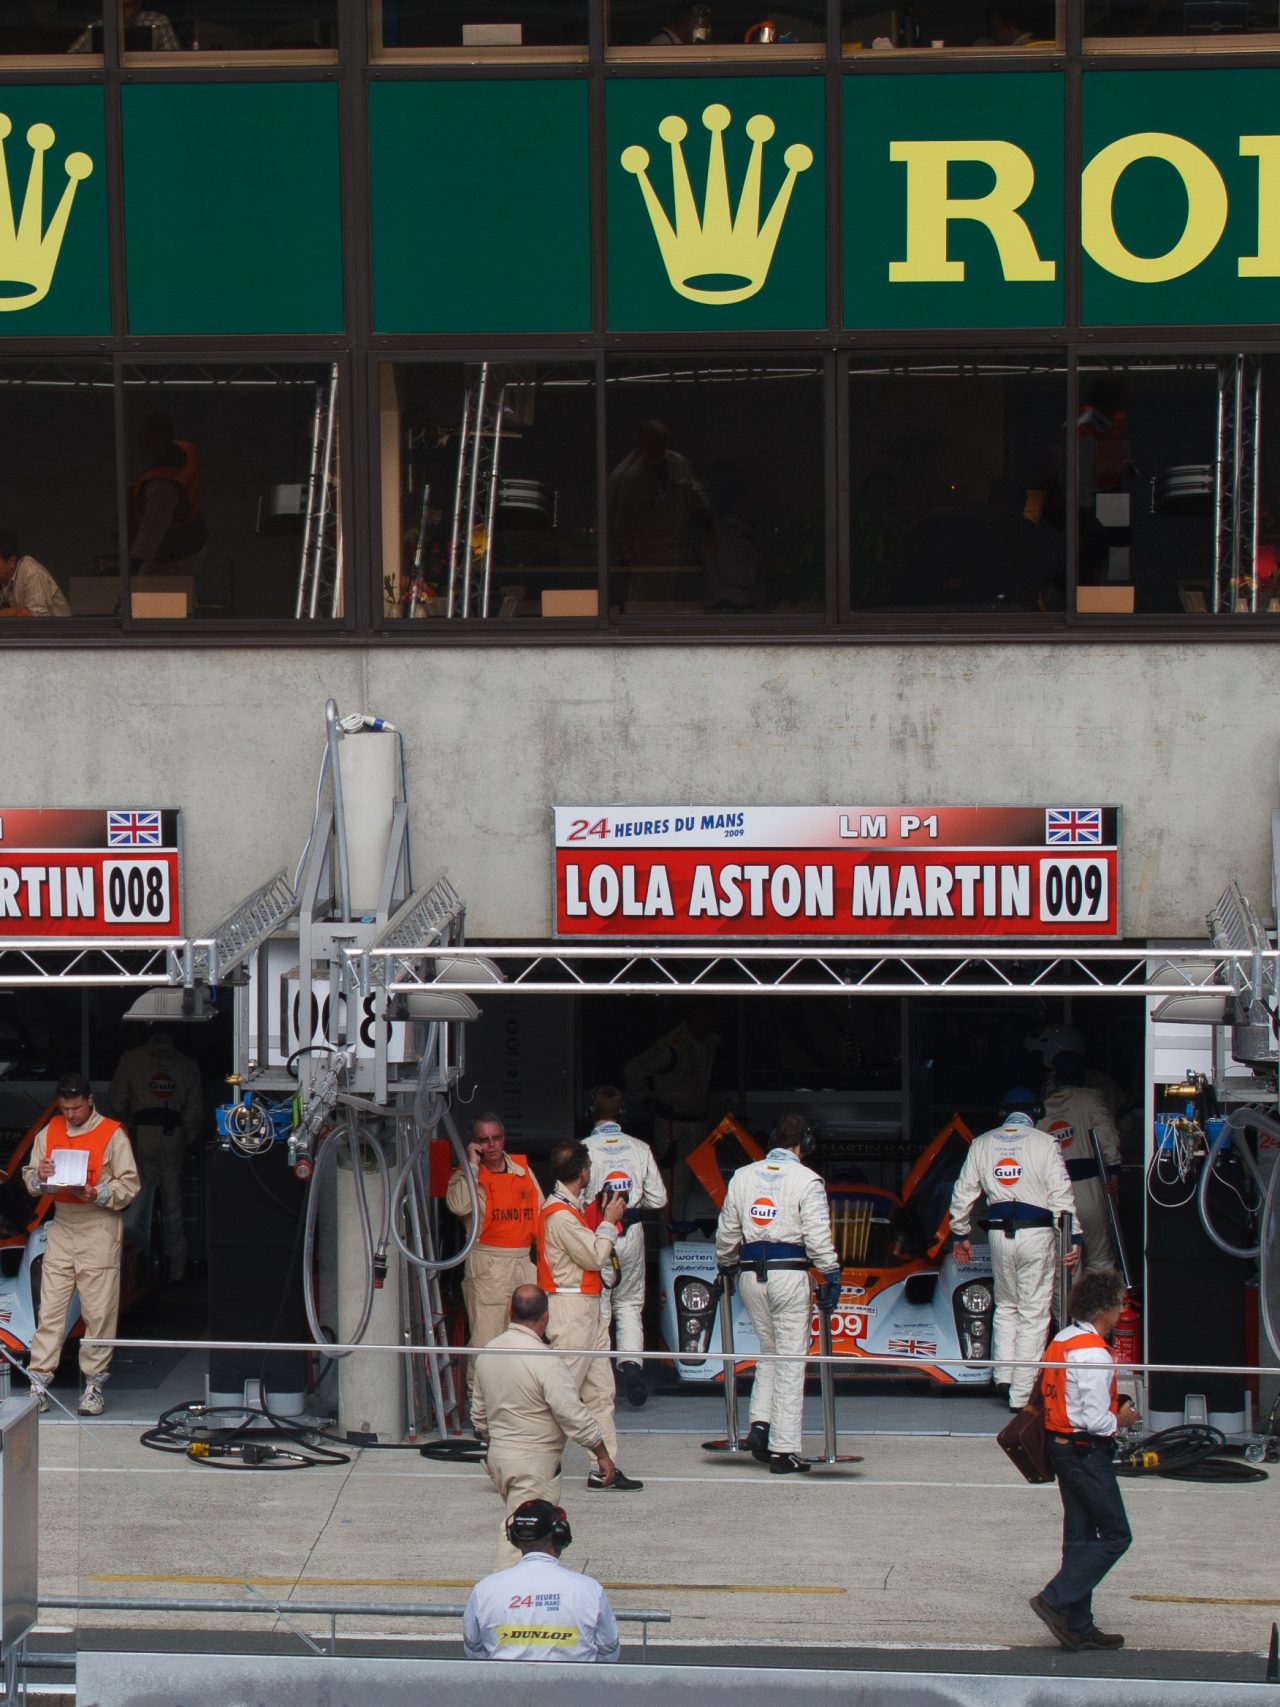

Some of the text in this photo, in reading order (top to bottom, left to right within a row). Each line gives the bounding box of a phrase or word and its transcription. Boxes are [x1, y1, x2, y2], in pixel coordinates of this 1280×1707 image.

[888, 131, 1280, 283] RO
[567, 812, 744, 841] 24 HEURES DU MANS
[724, 828, 745, 838] 2009
[839, 815, 938, 838] LM P1
[109, 866, 164, 917] 008
[565, 864, 1030, 917] LOLA ASTON MARTIN
[1046, 864, 1102, 917] 009
[995, 1168, 1022, 1177] Gulf
[609, 1180, 632, 1190] ulf
[750, 1206, 778, 1218] Gulf
[509, 1594, 534, 1609] 24
[510, 1630, 573, 1641] DUNLOP
